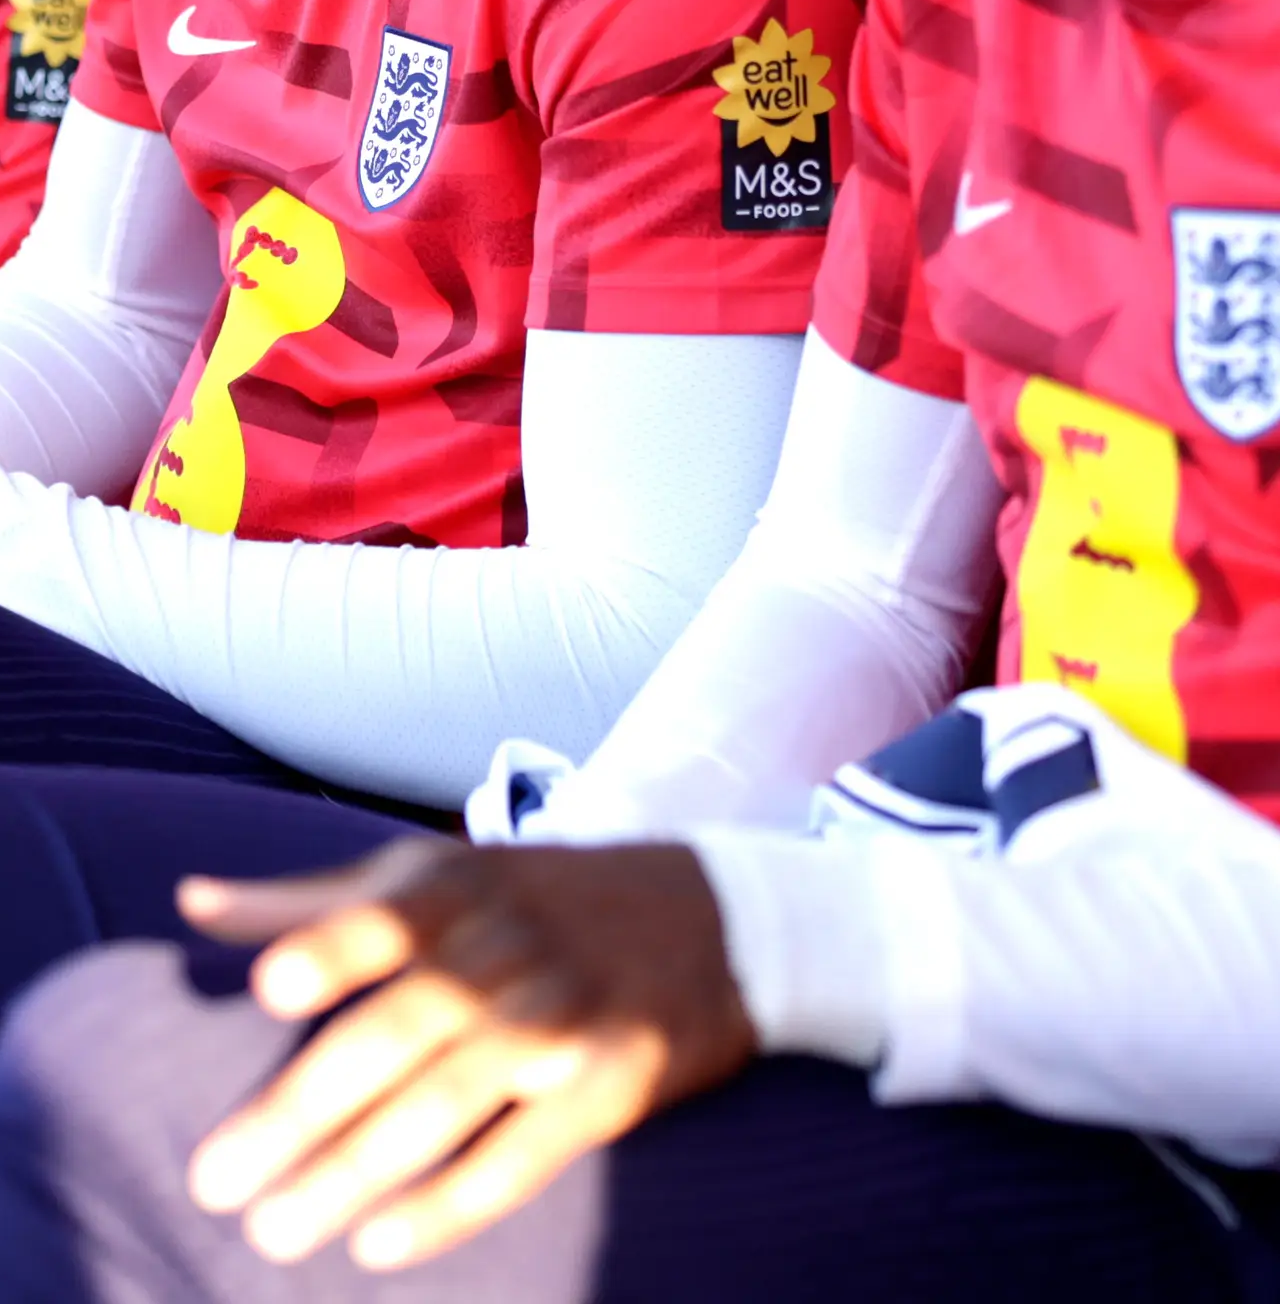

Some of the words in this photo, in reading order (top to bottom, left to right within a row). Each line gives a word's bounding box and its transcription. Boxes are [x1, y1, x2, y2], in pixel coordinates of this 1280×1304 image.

[14, 66, 77, 102] M&
[742, 50, 798, 85] eat
[744, 73, 809, 112] well
[734, 159, 822, 201] M&S
[753, 204, 804, 219] FOOD
